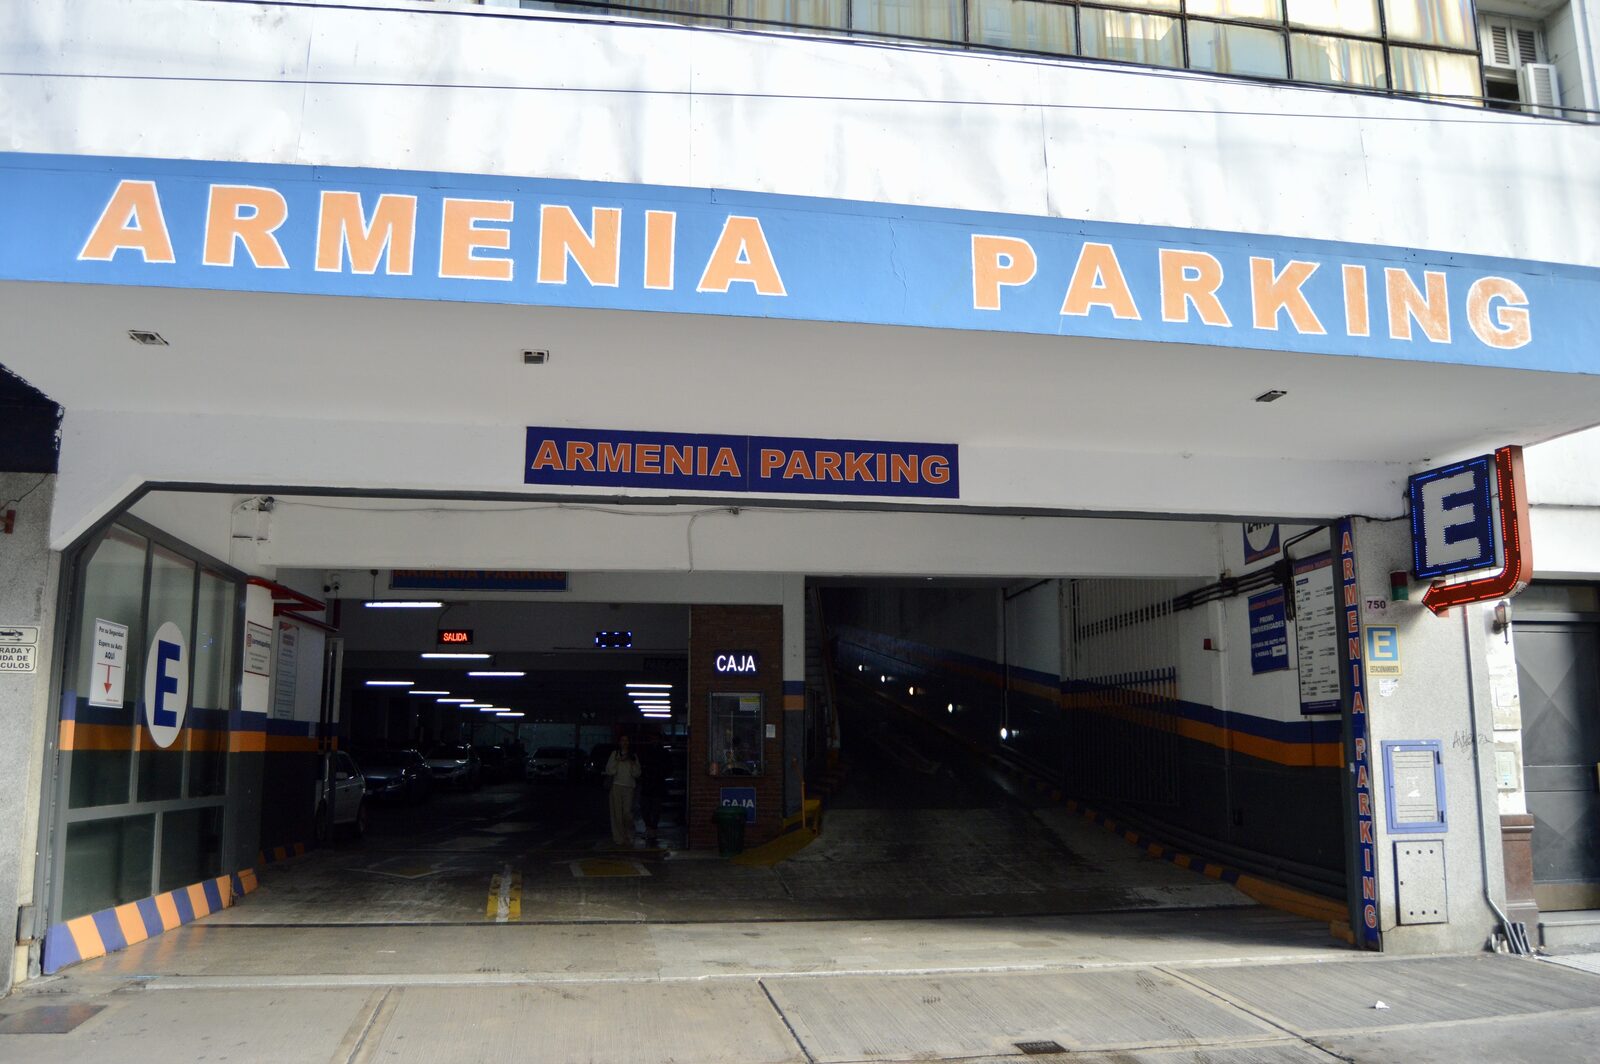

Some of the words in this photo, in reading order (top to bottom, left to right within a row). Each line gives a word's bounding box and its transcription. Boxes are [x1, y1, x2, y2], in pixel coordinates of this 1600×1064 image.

[77, 179, 787, 296] ARMENIA
[971, 233, 1532, 350] PARKING
[531, 440, 741, 477] ARMENIA
[760, 448, 951, 484] PARKING
[1421, 470, 1482, 568] E
[1367, 600, 1387, 609] 750
[443, 632, 468, 642] SALIDA
[1373, 631, 1393, 658] E
[716, 655, 756, 672] CAJA
[1370, 665, 1399, 673] ESTACIONAMIENTO
[153, 639, 181, 728] E
[1341, 531, 1365, 715] ARMENIA
[1355, 738, 1377, 929] PARKING
